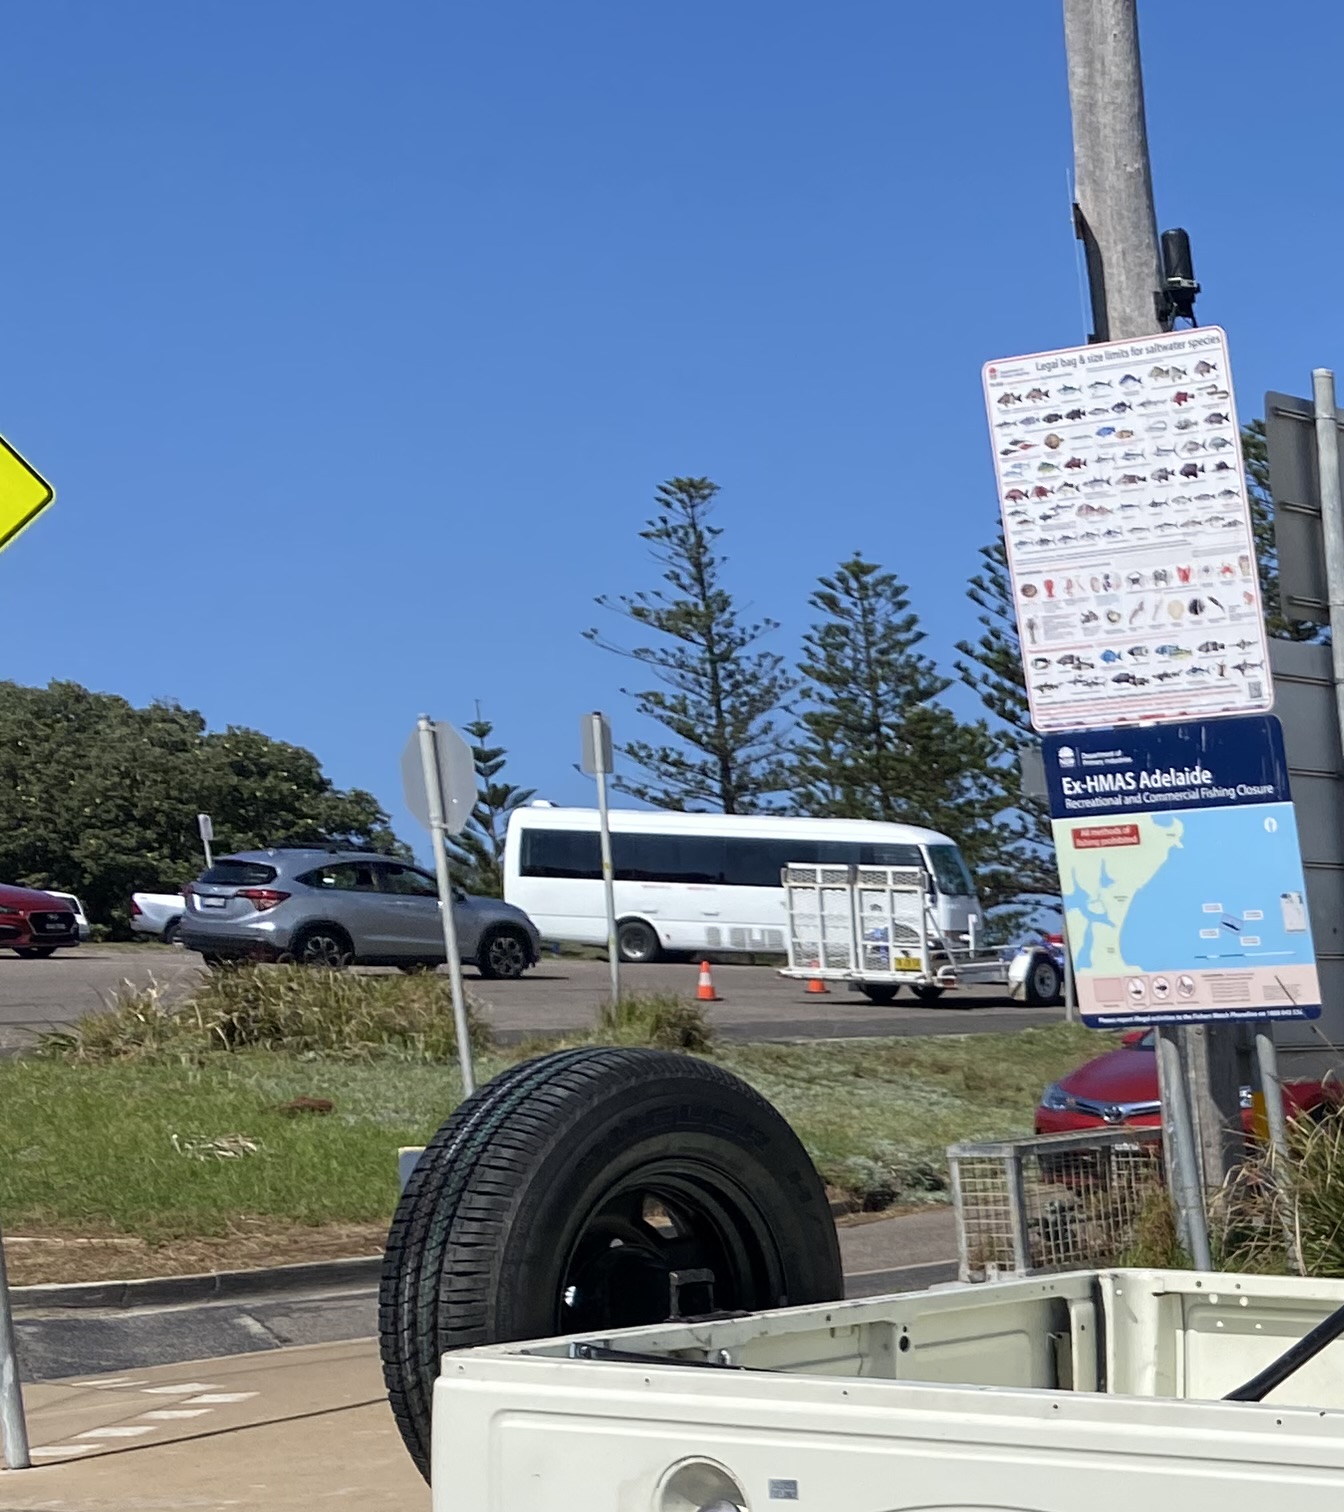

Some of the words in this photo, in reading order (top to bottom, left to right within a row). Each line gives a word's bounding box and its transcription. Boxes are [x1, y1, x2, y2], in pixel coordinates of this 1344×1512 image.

[1035, 358, 1058, 372] Legal
[1060, 357, 1077, 368] bag
[1079, 354, 1085, 364] &
[1087, 354, 1103, 363] size
[1104, 349, 1129, 360] limits
[1131, 346, 1143, 356] for
[1145, 341, 1186, 354] saltwater
[1187, 336, 1220, 350] species
[1062, 772, 1137, 795] Ex-HMAS
[1139, 766, 1212, 789] Adelaide
[1065, 795, 1121, 809] Recreational
[1123, 793, 1142, 804] and
[1143, 788, 1199, 803] Commercial
[1201, 786, 1236, 799] Fishing
[1236, 784, 1274, 796] Closure
